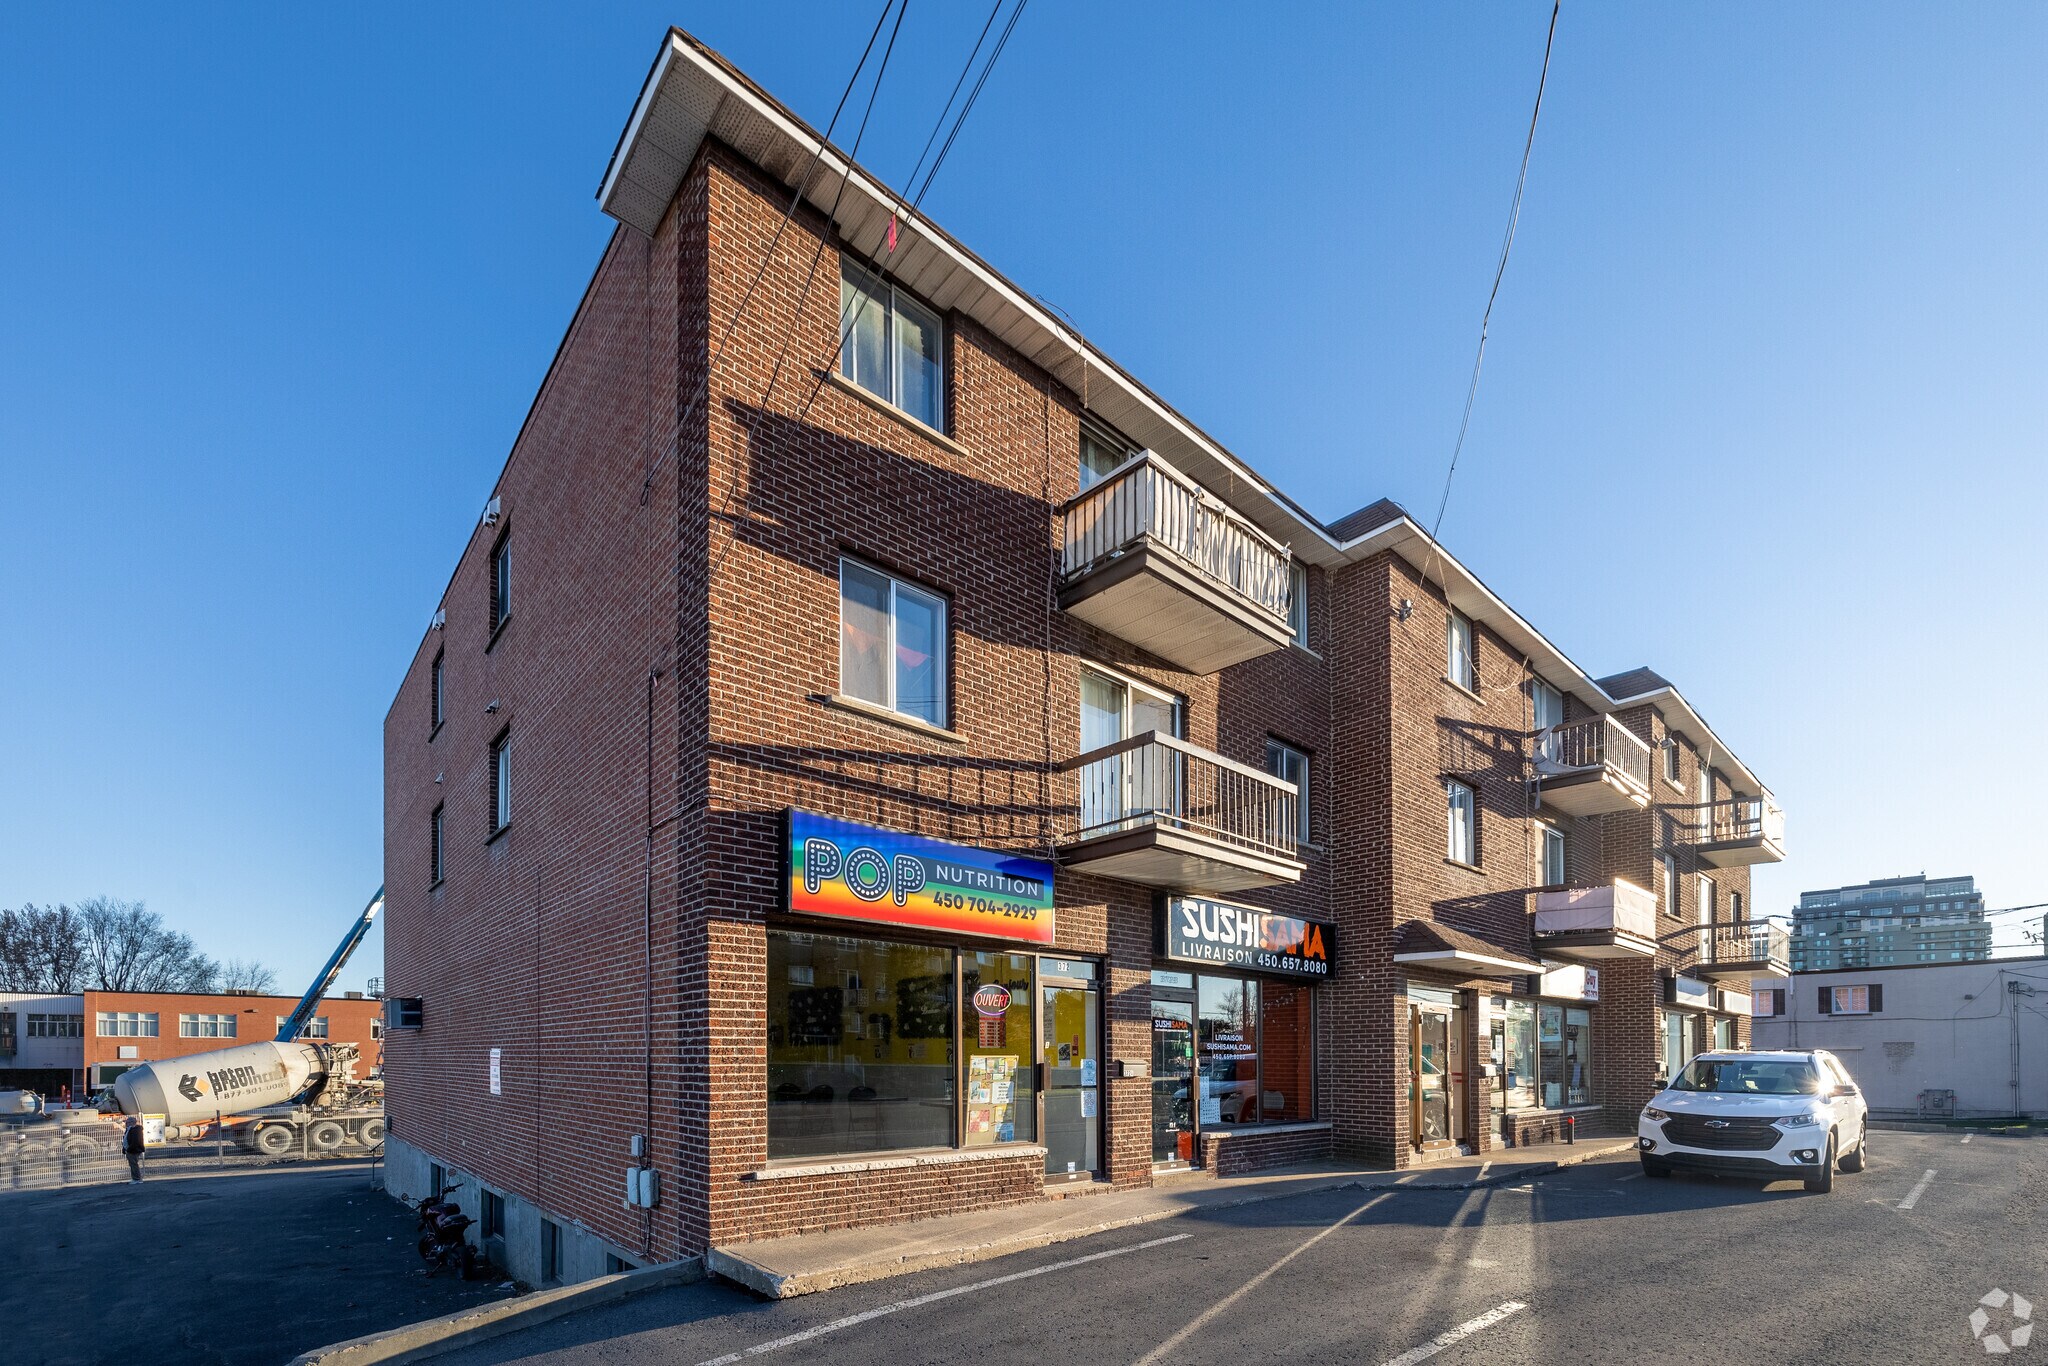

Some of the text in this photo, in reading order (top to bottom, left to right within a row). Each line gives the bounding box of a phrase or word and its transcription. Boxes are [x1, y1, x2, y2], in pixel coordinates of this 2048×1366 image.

[804, 837, 1039, 906] POP NUTRITION
[933, 891, 1037, 921] 450 704-2929
[1182, 941, 1327, 975] LIVRAISON 450.657.8080
[976, 993, 1009, 1007] OUVERT
